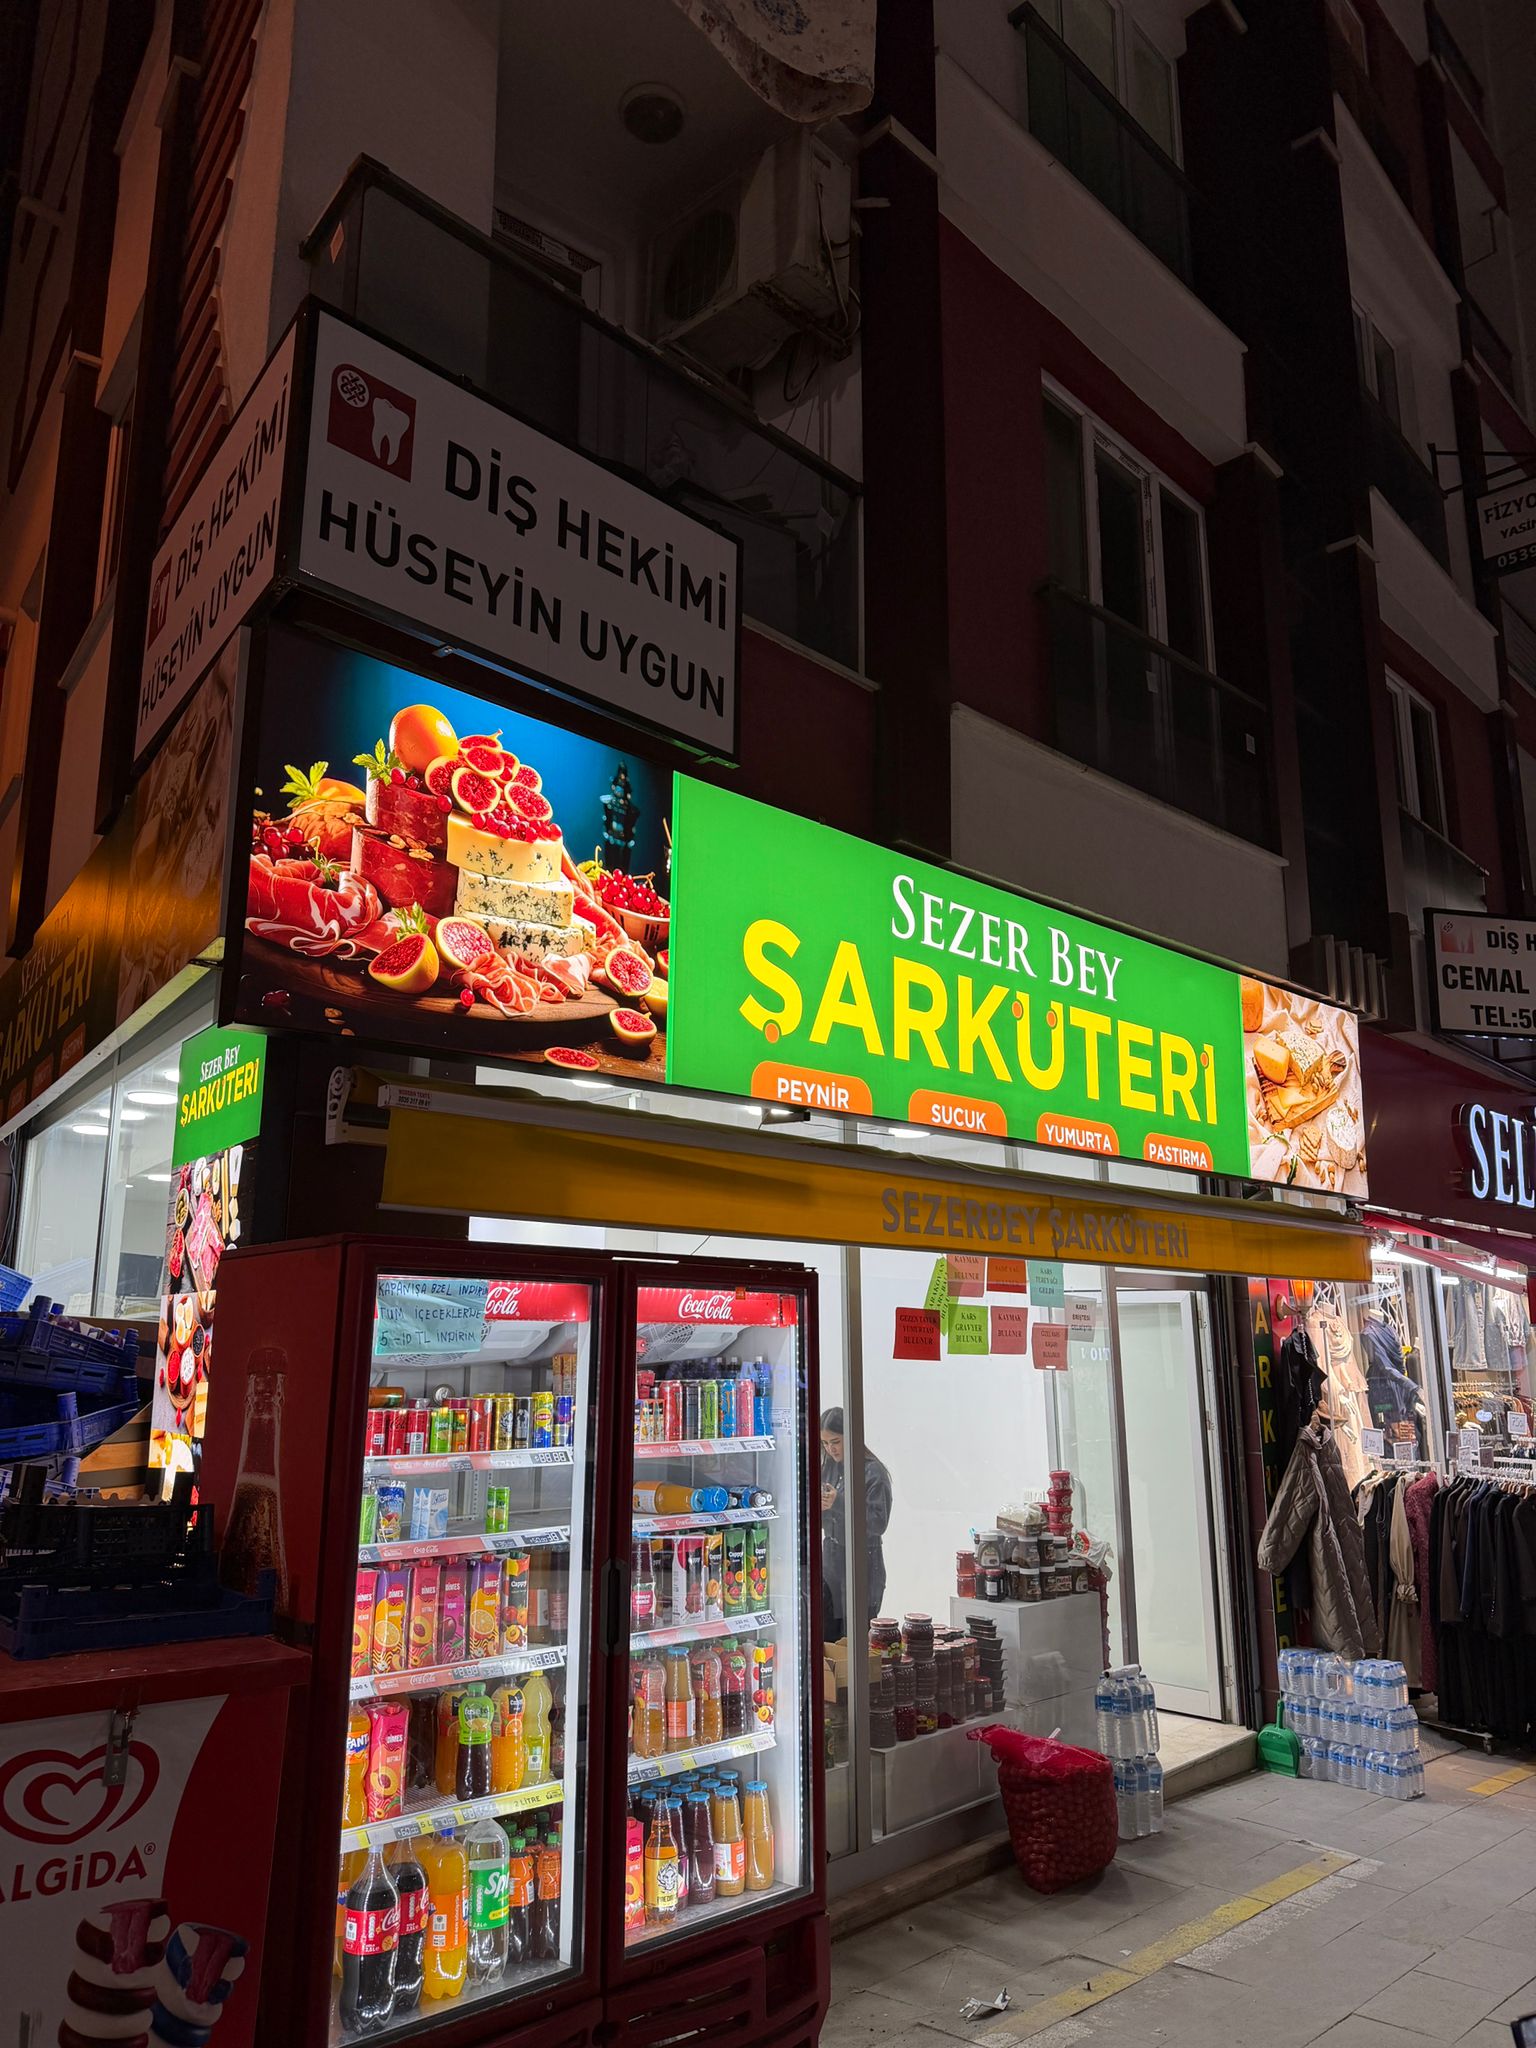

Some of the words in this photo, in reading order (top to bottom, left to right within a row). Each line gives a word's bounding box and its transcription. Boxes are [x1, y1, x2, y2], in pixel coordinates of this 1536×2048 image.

[175, 520, 204, 601] DİŞ
[209, 373, 288, 549] HEKİMİ
[446, 440, 537, 536] DİŞ
[558, 498, 726, 630] HEKİMİ
[140, 601, 205, 726] HÜSEYİN
[209, 497, 277, 628] UYGUN
[320, 489, 562, 644] HÜSEYİN
[581, 610, 724, 717] UYGUN
[891, 874, 1037, 978] SEZER
[1048, 927, 1122, 1001] BEY
[1486, 925, 1519, 955] DİŞ
[1442, 964, 1530, 994] CEMAL
[738, 919, 1217, 1125] ŞARKÜTERİ
[1470, 1004, 1536, 1029] TEL:5
[200, 1061, 222, 1082] SEZER
[224, 1044, 240, 1070] BEY
[777, 1077, 849, 1109] PEYNİR
[931, 1104, 987, 1131] SUCUK
[1045, 1124, 1113, 1152] YUMURTA
[1148, 1143, 1207, 1168] PASTIRMA
[1469, 1103, 1536, 1209] SEL
[881, 1187, 1040, 1244] SEZERBEY
[1051, 1208, 1189, 1258] ŞARKÜTERİ
